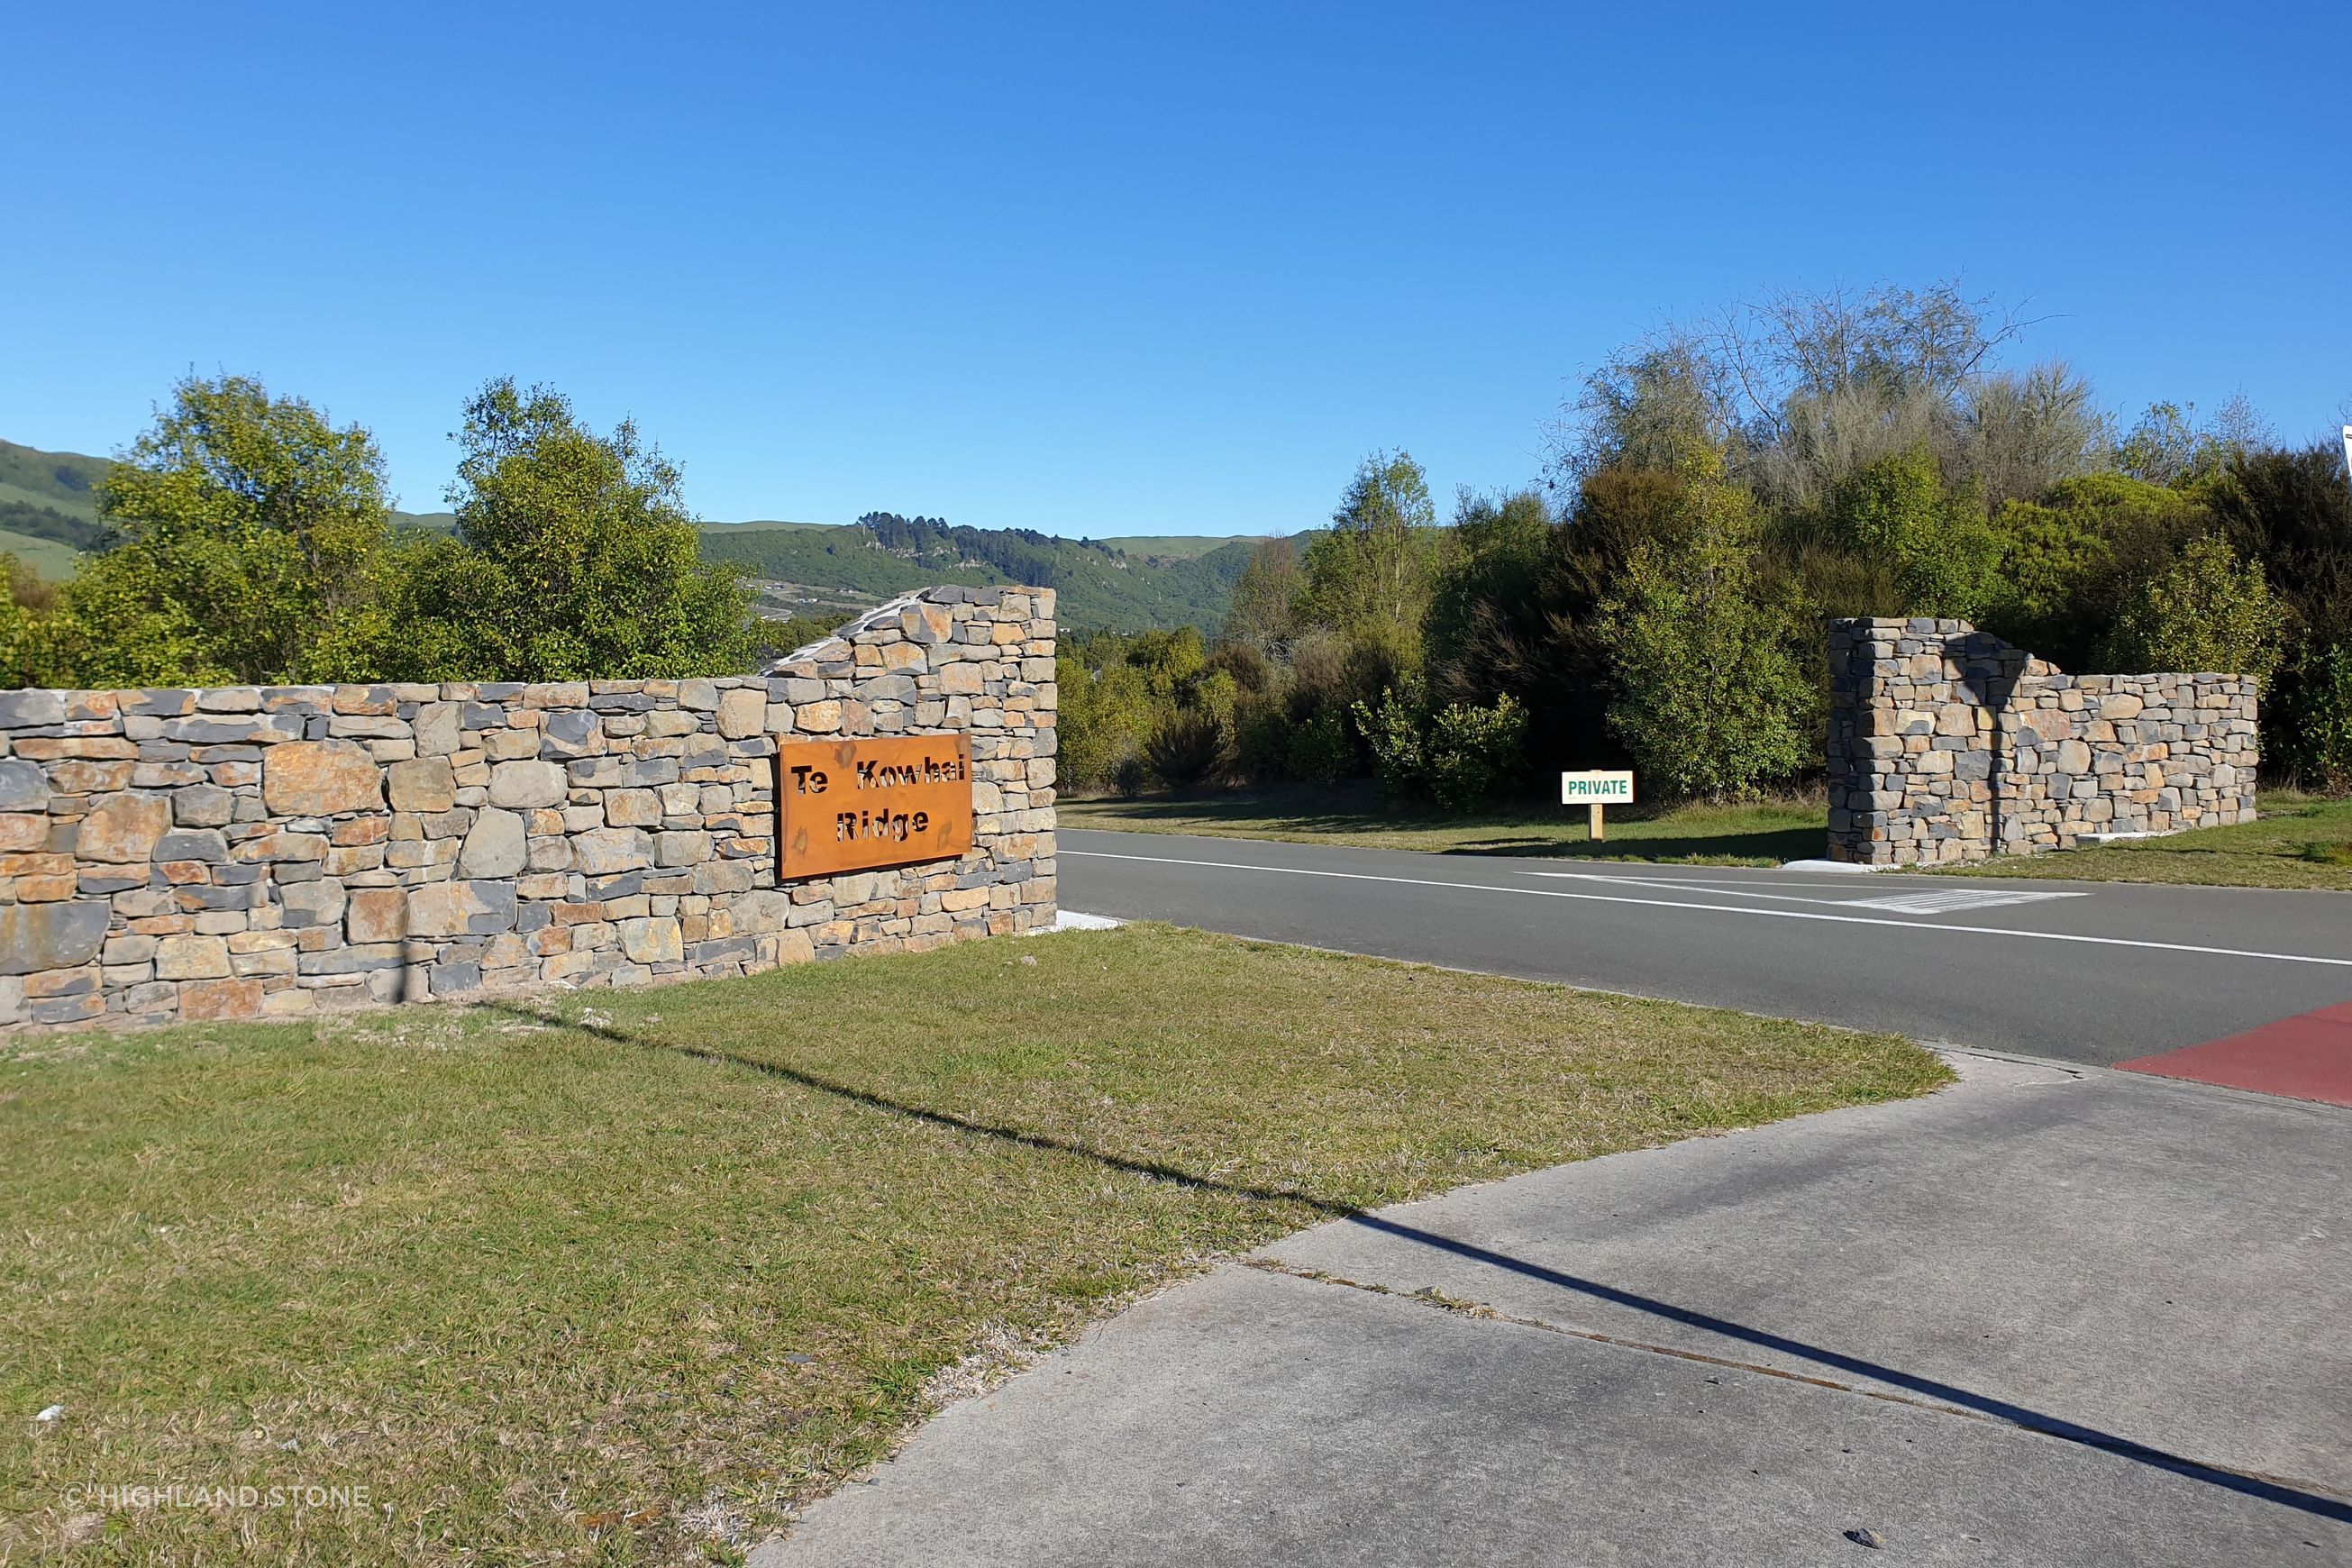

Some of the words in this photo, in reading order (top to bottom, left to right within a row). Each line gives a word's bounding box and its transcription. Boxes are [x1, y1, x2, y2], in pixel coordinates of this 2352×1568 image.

[791, 765, 828, 795] Te
[857, 754, 966, 789] Kowhai
[1568, 779, 1627, 795] PRIVATE
[836, 808, 929, 843] Ridge
